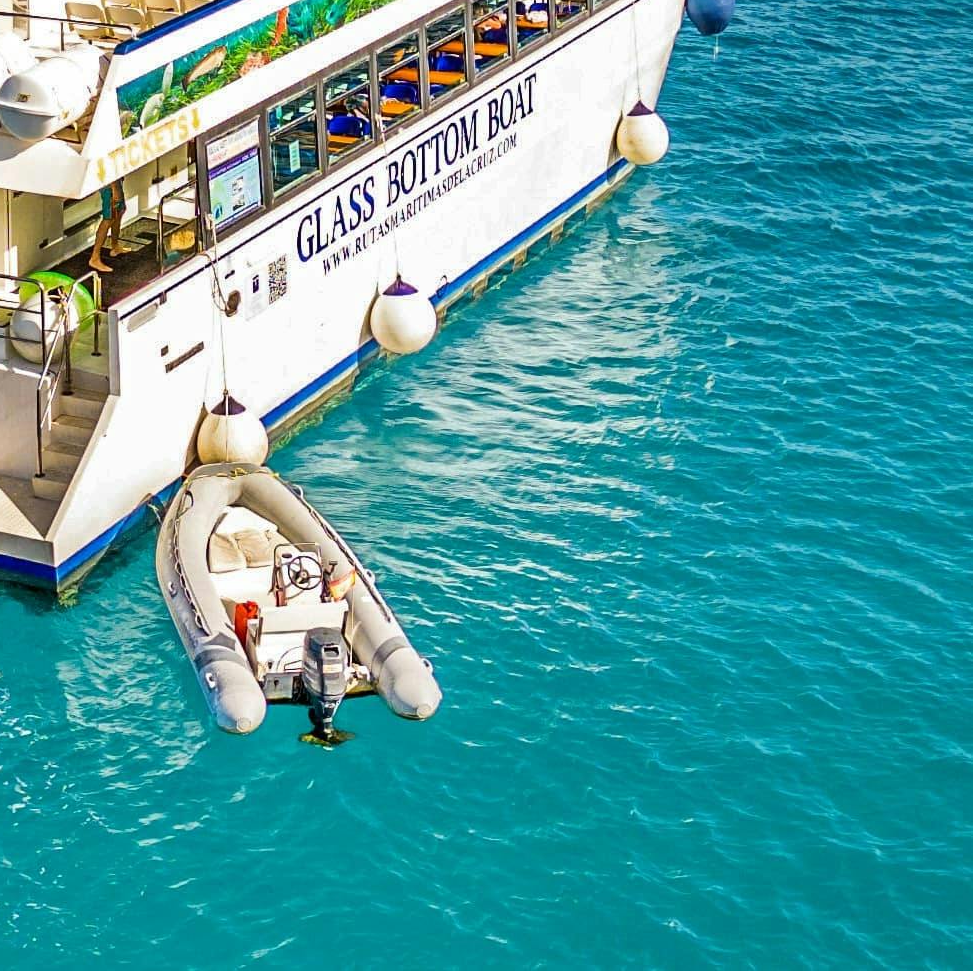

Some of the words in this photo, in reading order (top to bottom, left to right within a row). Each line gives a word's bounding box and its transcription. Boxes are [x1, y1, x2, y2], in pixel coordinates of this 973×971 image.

[107, 115, 189, 173] TICKETS
[296, 176, 375, 263] GLASS
[386, 109, 479, 207] BOTTOM
[487, 73, 537, 141] BOAT
[323, 132, 518, 276] WWW.RUTASMARITIMASDELACRUZ.COM
